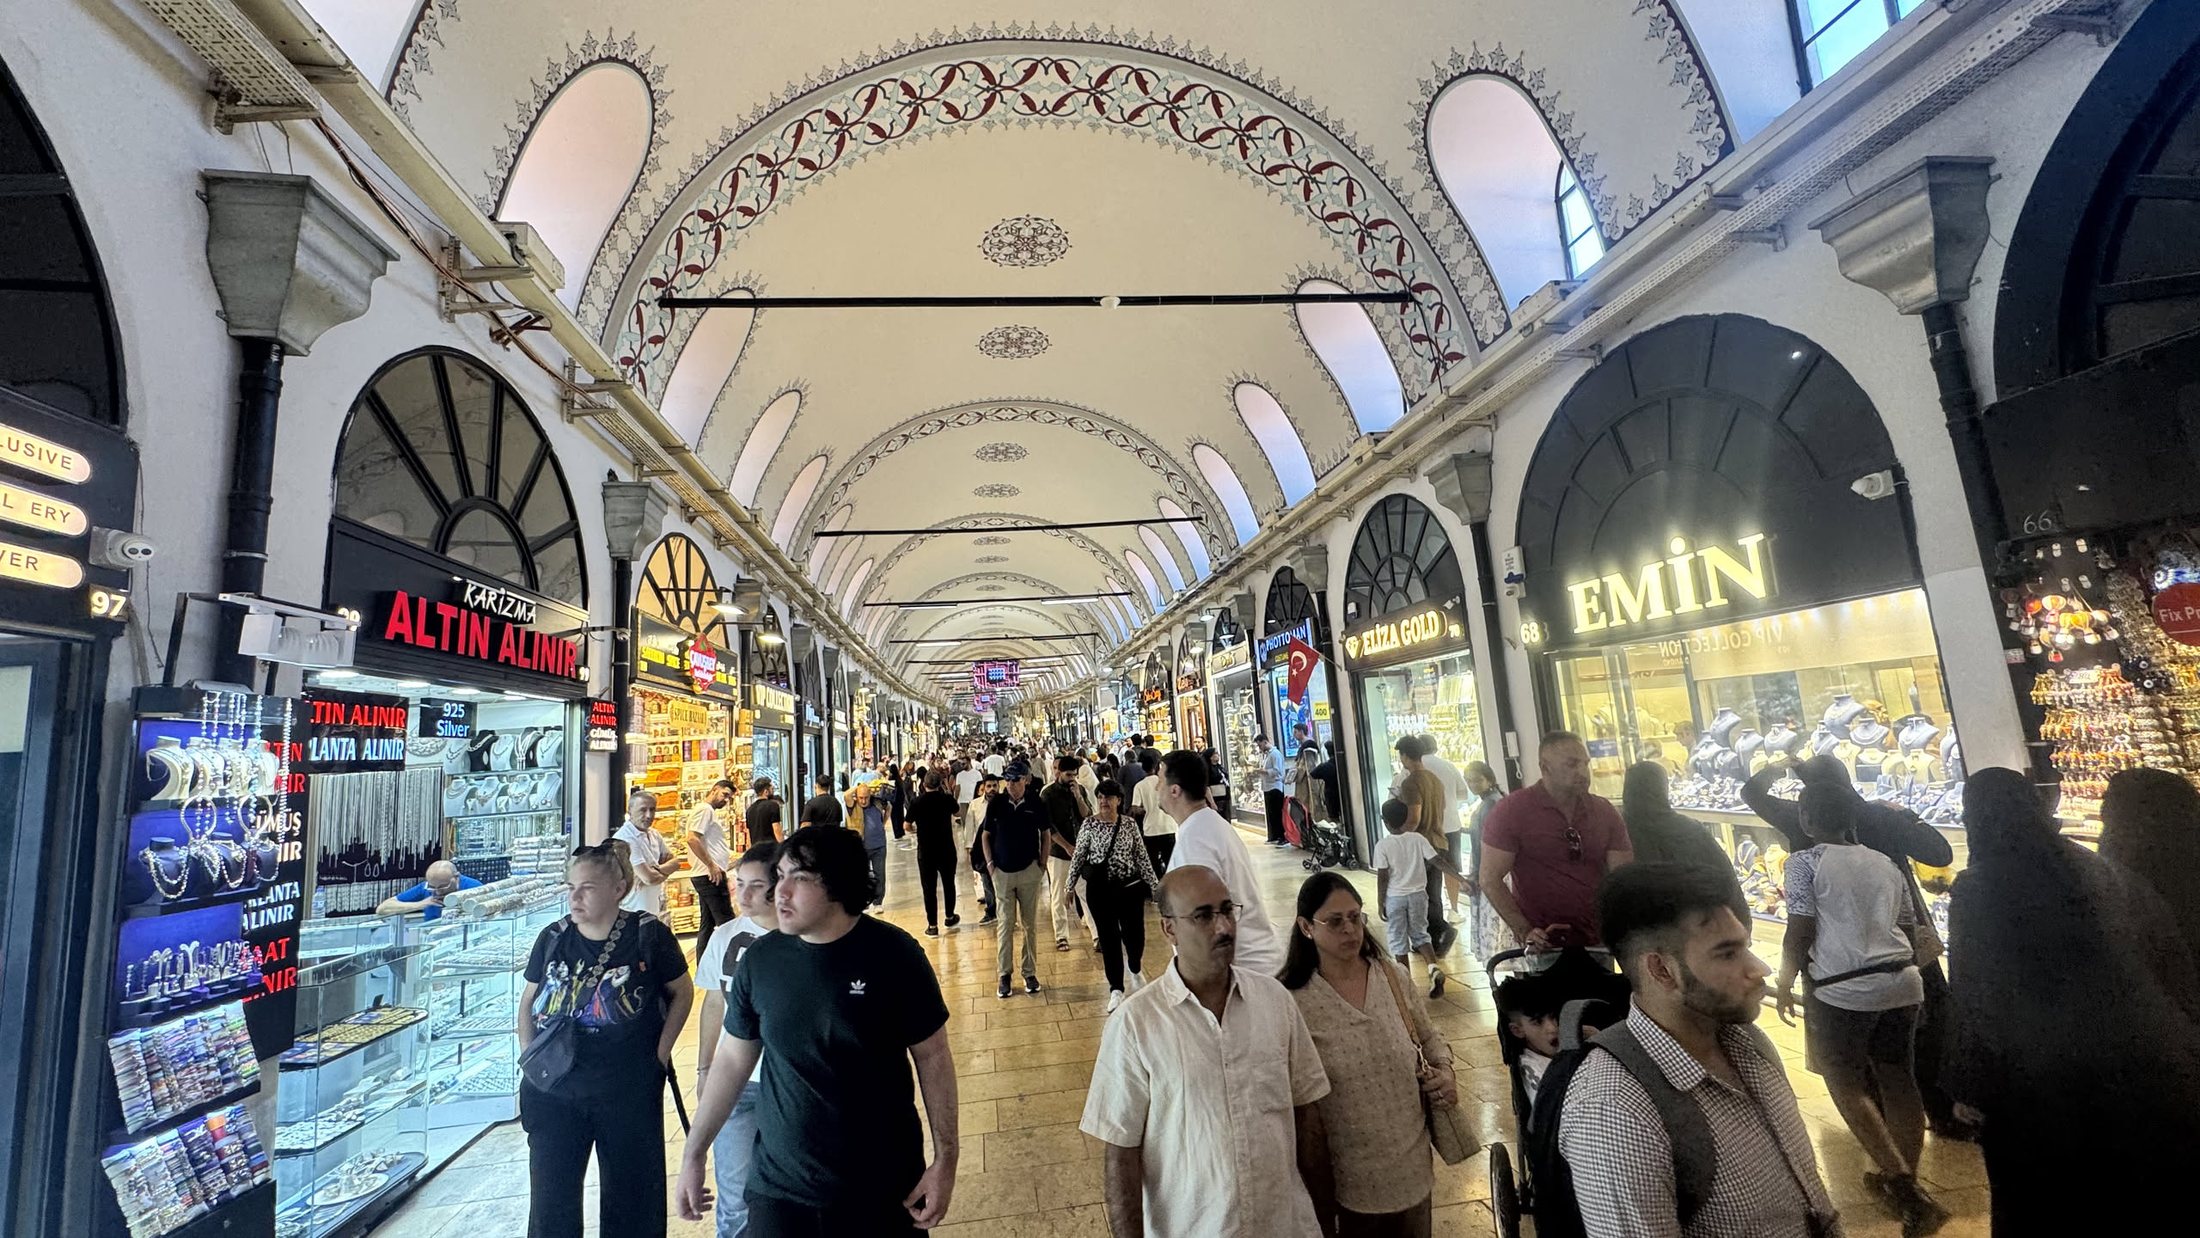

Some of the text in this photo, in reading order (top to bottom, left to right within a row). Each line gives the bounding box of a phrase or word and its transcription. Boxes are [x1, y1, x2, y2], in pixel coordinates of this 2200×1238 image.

[0, 436, 72, 470] USIVE
[2023, 509, 2052, 534] 66
[1567, 532, 1768, 634] EMİN
[90, 591, 127, 616] 97
[463, 581, 537, 624] KARİZMA
[2159, 608, 2184, 622] Fix
[385, 590, 577, 679] ALTIN ALINIR
[1362, 610, 1439, 656] ELİZA GOLD
[1520, 621, 1540, 644] 68
[310, 701, 407, 727] TIN ALINIR
[443, 702, 465, 718] 925
[590, 714, 617, 726] ALINIR
[593, 702, 615, 713] ALTIN
[436, 719, 470, 738] Silver
[362, 738, 404, 760] ALINIR
